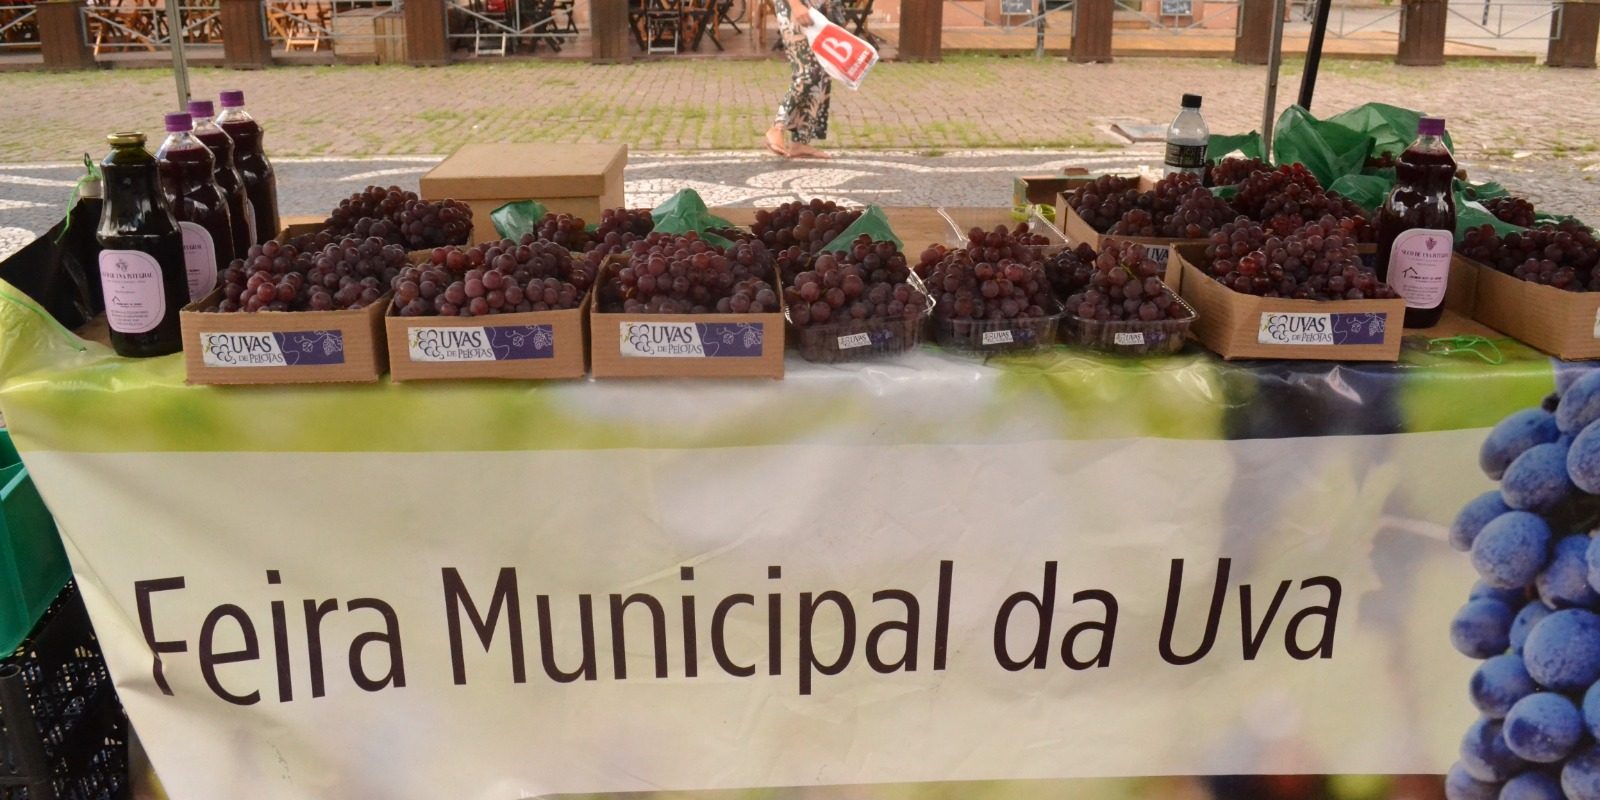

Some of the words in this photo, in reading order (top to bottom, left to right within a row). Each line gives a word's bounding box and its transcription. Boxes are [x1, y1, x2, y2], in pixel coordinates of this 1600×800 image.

[821, 36, 853, 64] B
[1289, 316, 1327, 333] UVAS
[438, 330, 482, 349] UVAS
[652, 325, 693, 344] UVAS
[1301, 332, 1333, 342] PELOTAS
[229, 335, 272, 354] UVAS
[458, 348, 493, 359] PELOTAS
[668, 343, 703, 355] PELOTAS
[249, 352, 284, 364] PELOTAS
[133, 570, 407, 706] Feira
[440, 560, 954, 695] Municipal
[993, 561, 1120, 671] da
[1158, 558, 1342, 665] Uva
